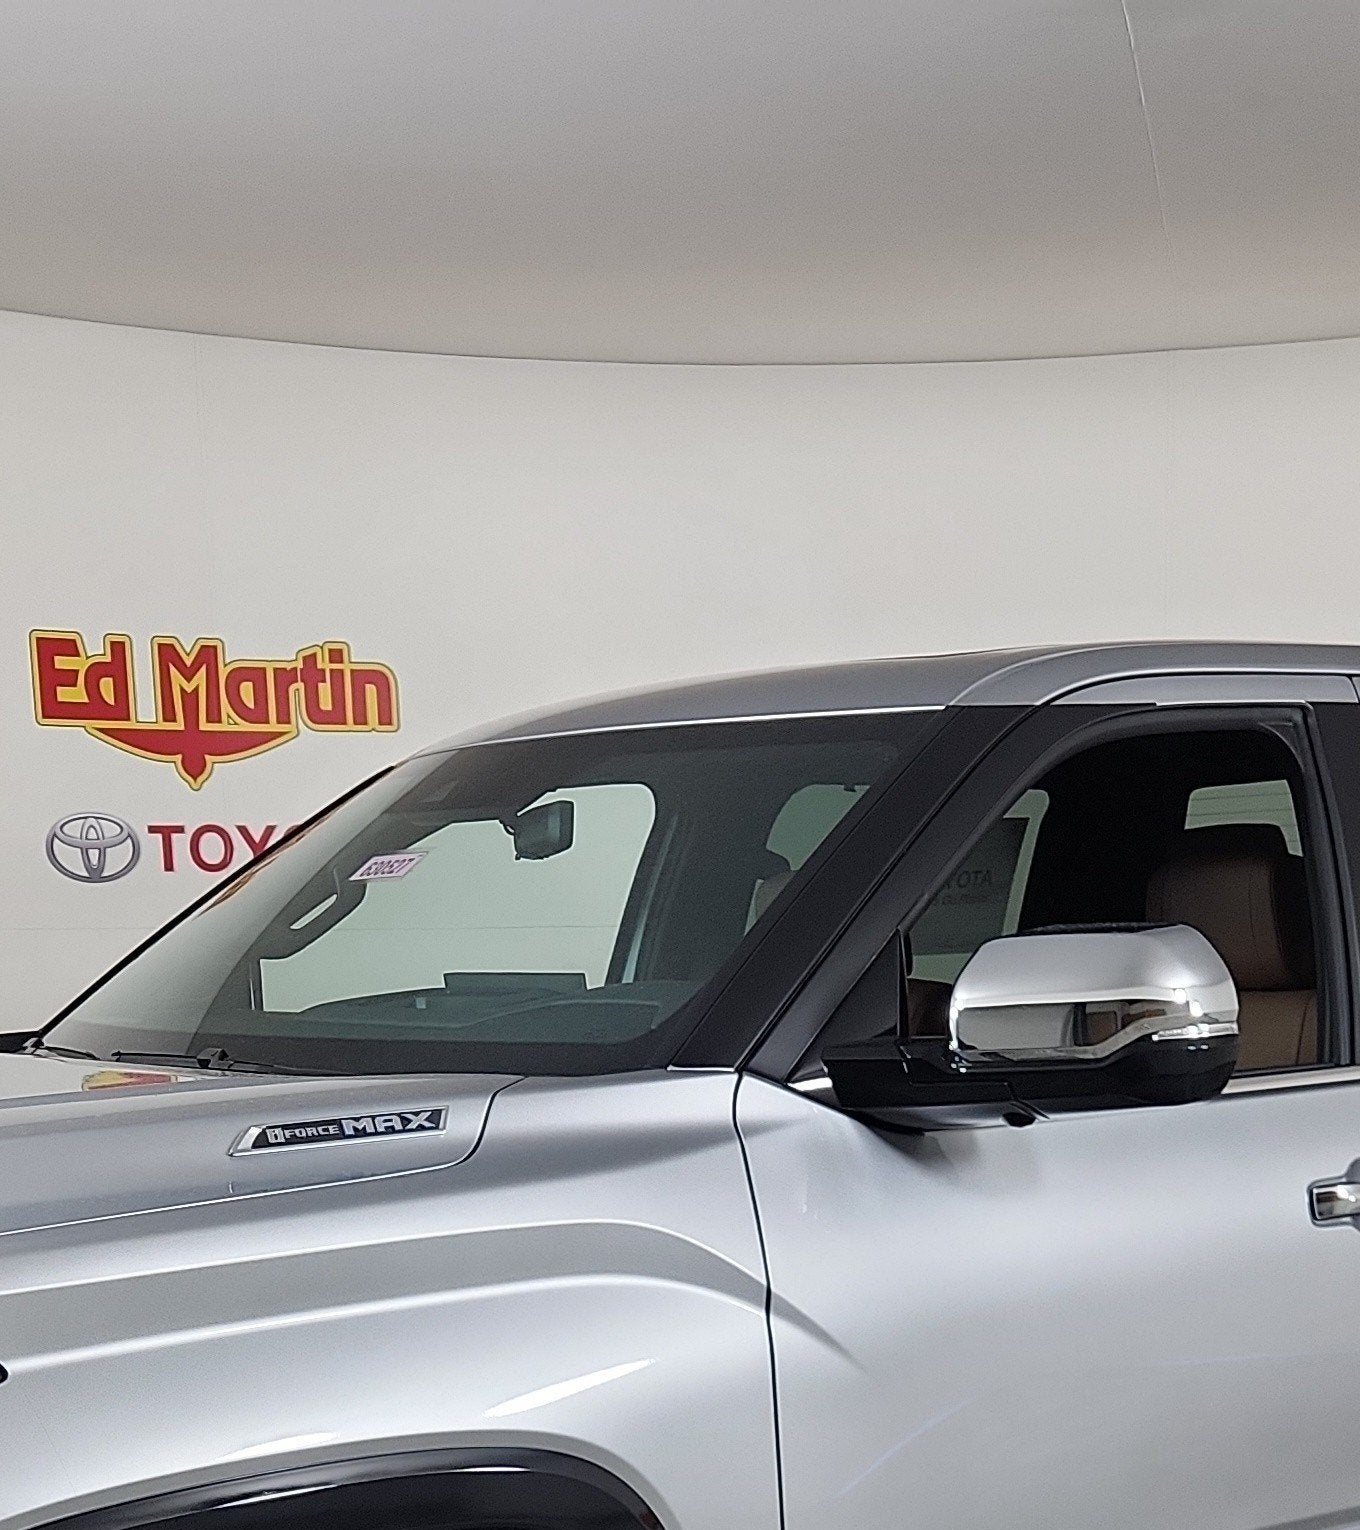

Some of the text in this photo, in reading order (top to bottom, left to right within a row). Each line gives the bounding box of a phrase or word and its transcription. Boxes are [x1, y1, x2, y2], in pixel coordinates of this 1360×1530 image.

[31, 630, 398, 730] Ed Martin
[147, 824, 304, 873] TOY
[341, 1111, 435, 1136] MAX
